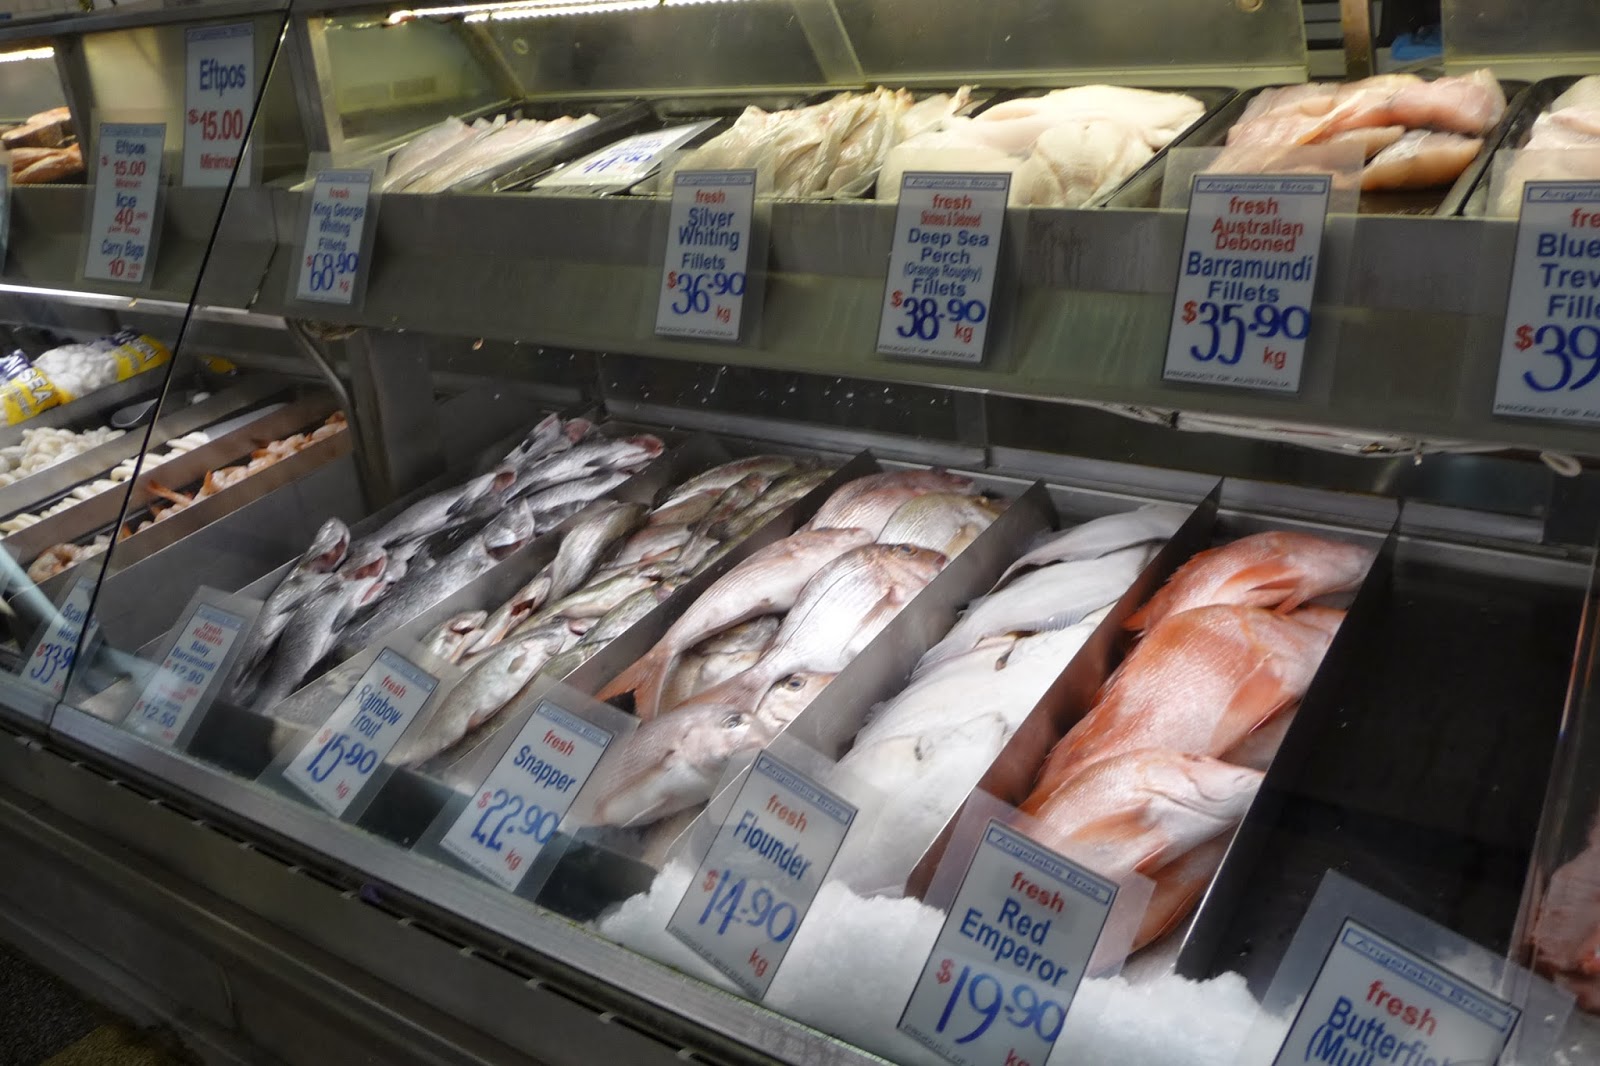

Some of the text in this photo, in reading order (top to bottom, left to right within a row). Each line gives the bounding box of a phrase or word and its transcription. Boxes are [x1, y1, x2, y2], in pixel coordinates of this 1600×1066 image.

[200, 58, 246, 97] Eftpos
[201, 154, 239, 169] Minimu
[116, 192, 137, 209] Ice
[695, 189, 726, 204] fresh
[932, 193, 972, 209] fresh
[1229, 195, 1280, 215] fresh
[115, 208, 134, 227] 40
[688, 207, 735, 227] Silver
[1211, 217, 1305, 237] Australian
[679, 225, 740, 251] Whiting
[907, 227, 990, 248] Deep Sea
[1215, 232, 1297, 253] Deboned
[109, 258, 125, 277] 10
[681, 252, 726, 270] Fillets
[920, 247, 971, 265] Perch
[1186, 251, 1315, 283] Barramundi
[911, 278, 967, 297] Fillets
[1208, 280, 1281, 303] Fillets
[716, 305, 732, 323] kg
[954, 323, 975, 344] kg
[1262, 346, 1288, 370] kg
[57, 624, 81, 642] Mea
[170, 646, 216, 672] Barramundi
[381, 674, 407, 699] fresh
[355, 683, 404, 727] Rainbow
[350, 709, 383, 741] Trout
[542, 729, 576, 757] fresh
[513, 744, 577, 794] Snapper
[336, 778, 350, 800] kg
[765, 793, 808, 834] fresh
[733, 809, 813, 881] Flounder
[504, 847, 524, 871] kg
[1010, 871, 1066, 915] fresh
[997, 897, 1052, 947] Red
[958, 906, 1069, 988] Emperor
[748, 947, 770, 977] kg
[1365, 978, 1438, 1037] fresh
[1327, 995, 1451, 1066] Butterfi
